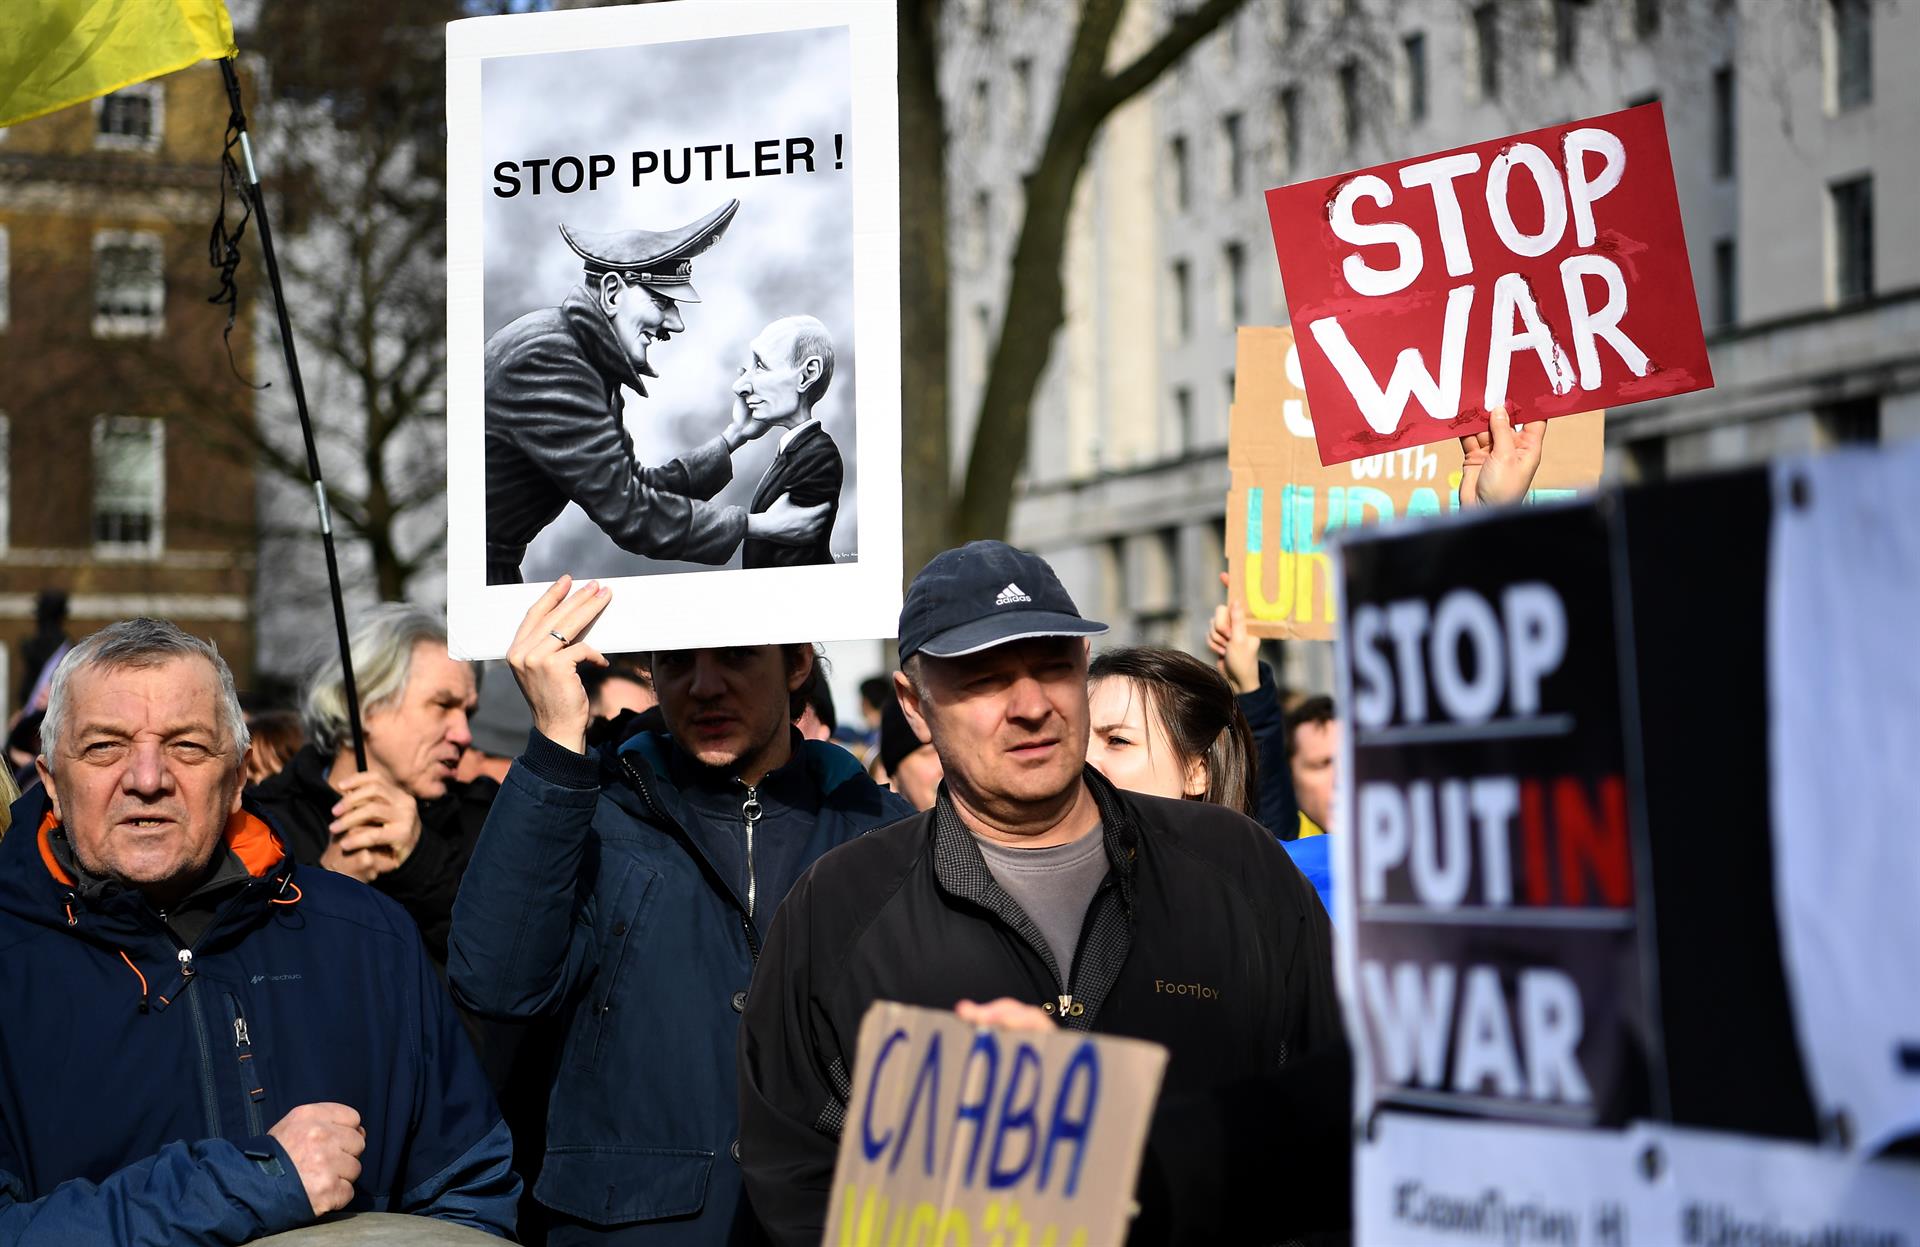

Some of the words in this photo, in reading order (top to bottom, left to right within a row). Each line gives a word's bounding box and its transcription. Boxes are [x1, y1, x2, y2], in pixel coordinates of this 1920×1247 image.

[493, 160, 616, 199] STOP
[632, 137, 816, 187] PUTLER
[1328, 127, 1627, 297] STOP
[1309, 253, 1652, 435] WAR
[995, 595, 1032, 606] adidas
[1354, 581, 1568, 728] STOP
[1360, 778, 1631, 909] PUTIN
[1362, 961, 1593, 1104] WAR
[860, 1028, 1102, 1198] СЛАВА
